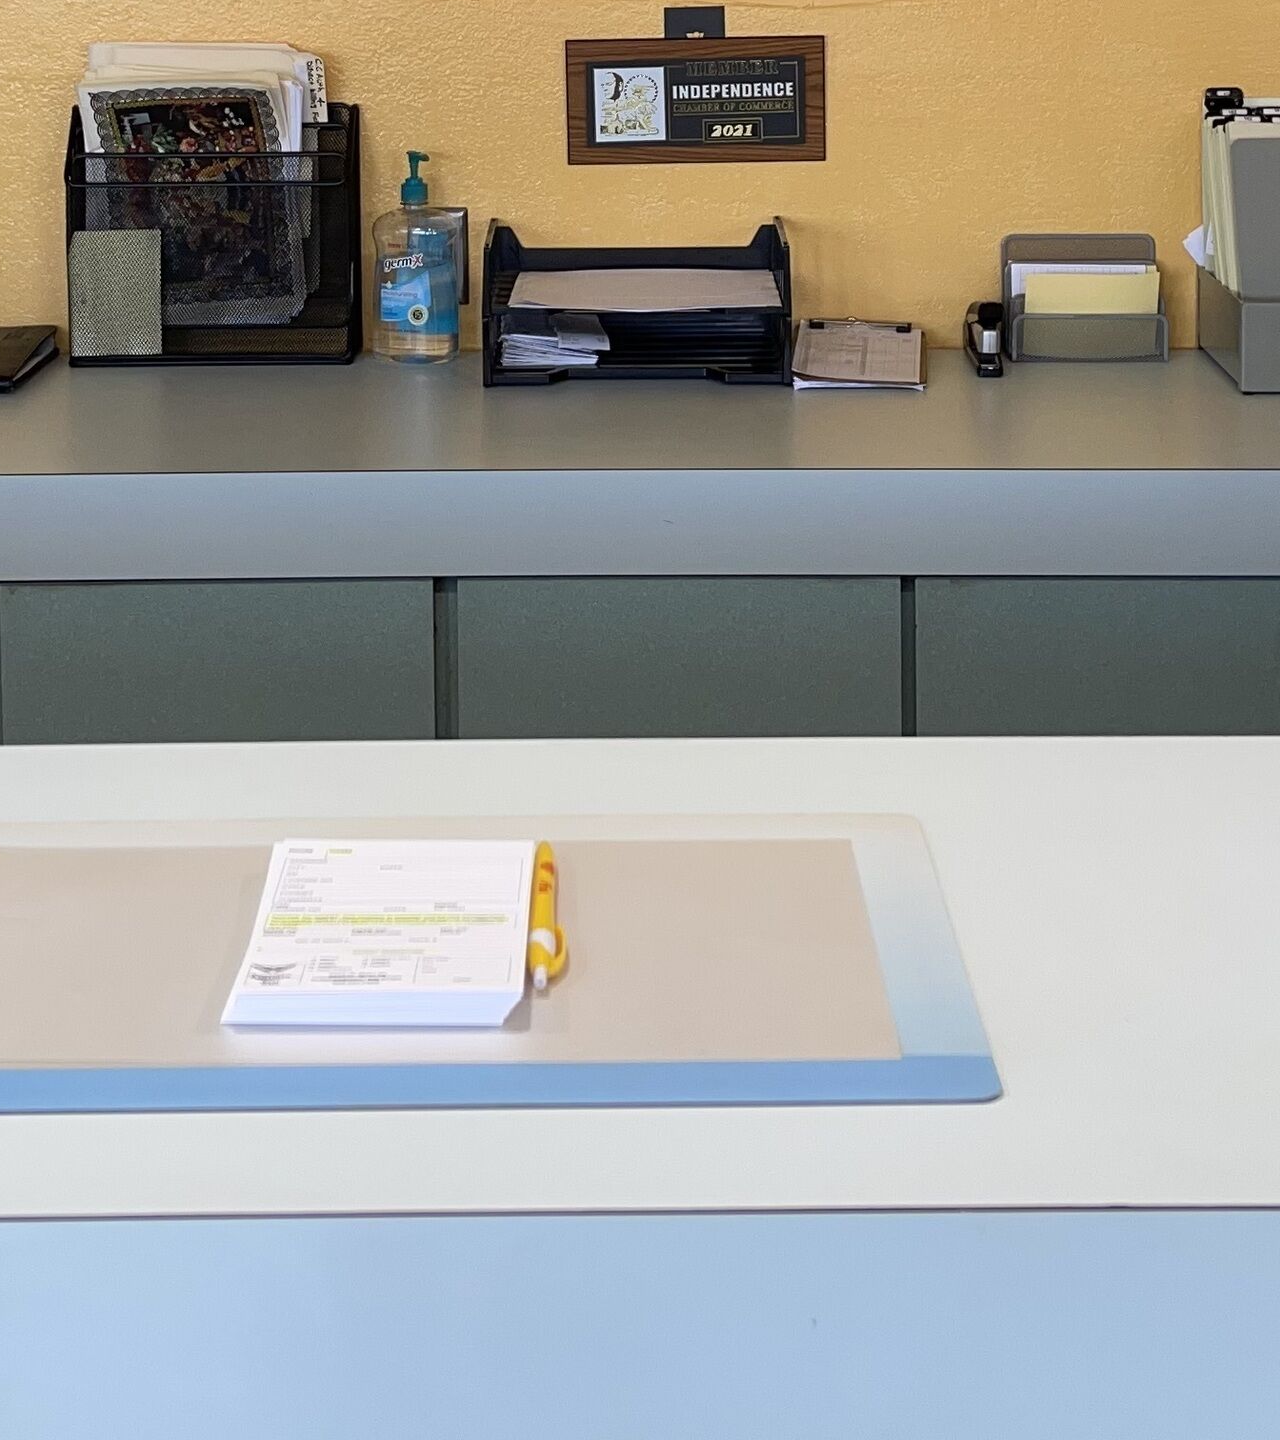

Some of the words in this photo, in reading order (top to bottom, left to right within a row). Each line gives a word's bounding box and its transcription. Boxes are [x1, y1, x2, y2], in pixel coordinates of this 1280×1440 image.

[685, 60, 780, 76] MEMBER
[672, 82, 795, 100] INDEPENDENCE
[672, 101, 720, 112] CHAMBER
[723, 101, 735, 111] OF
[738, 100, 795, 111] COMMERCE
[710, 124, 753, 137] 2021
